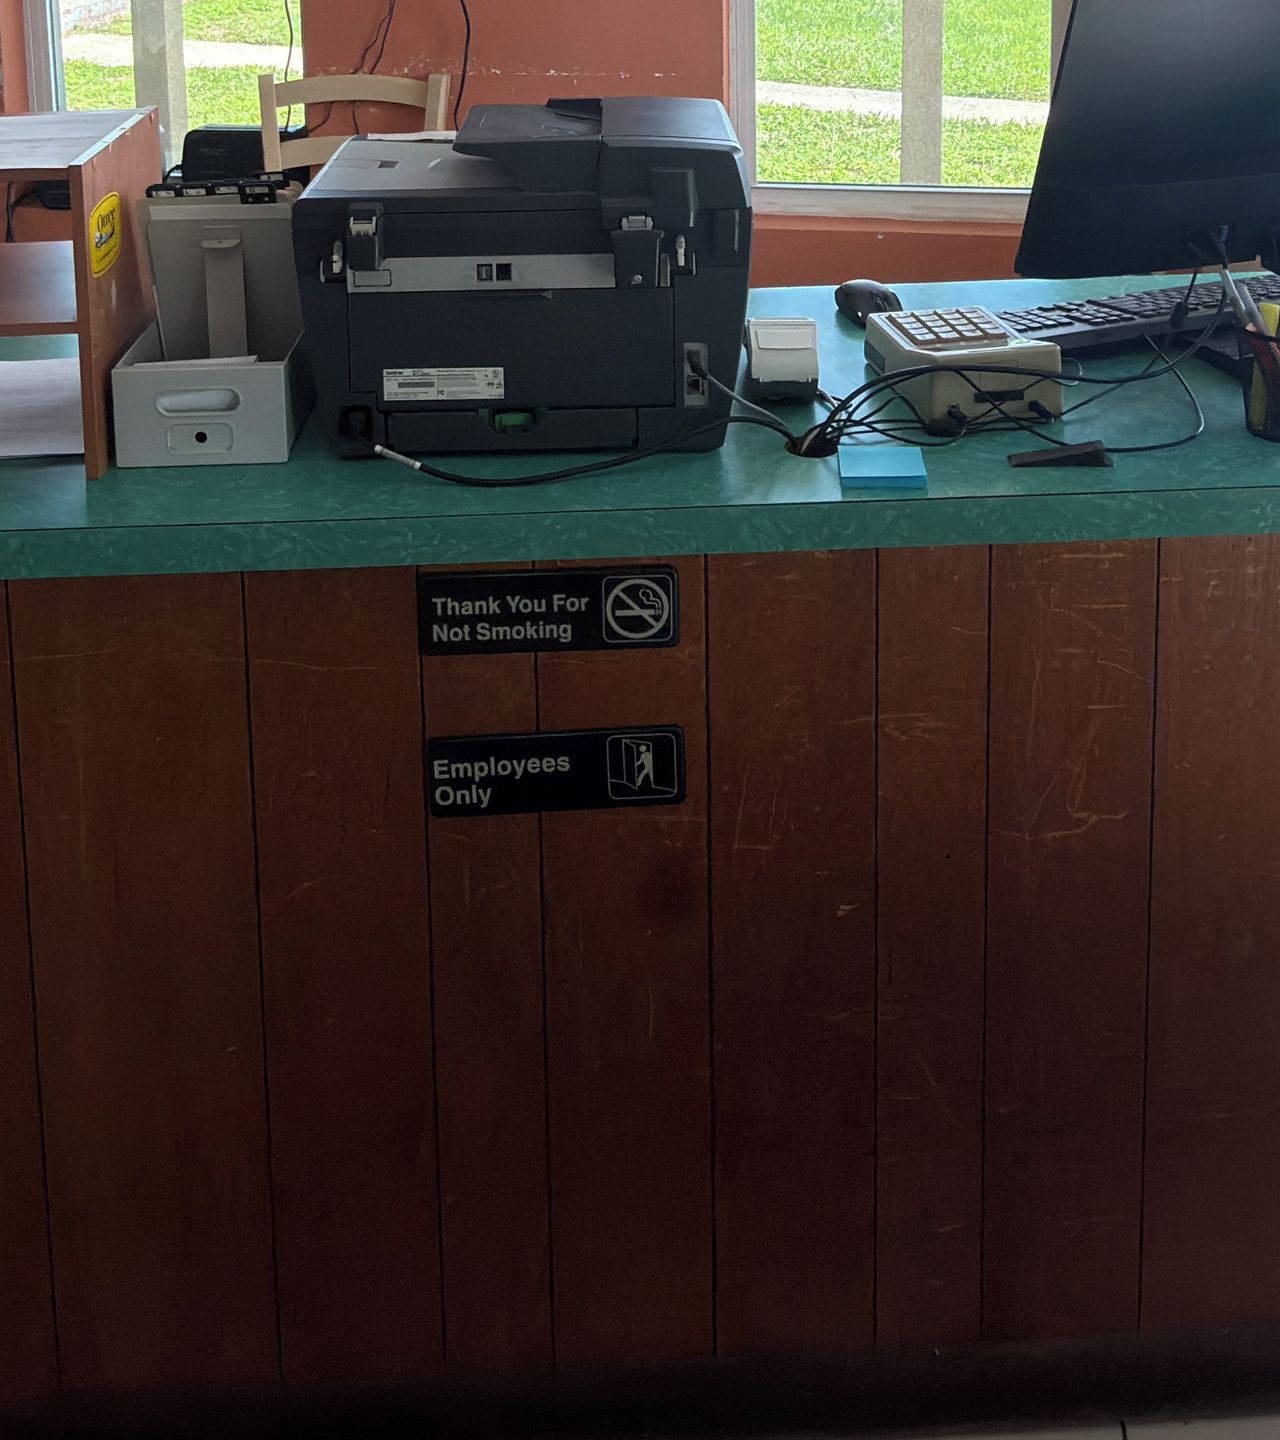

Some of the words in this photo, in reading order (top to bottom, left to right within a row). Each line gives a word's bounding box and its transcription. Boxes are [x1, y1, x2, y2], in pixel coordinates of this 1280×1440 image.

[431, 595, 502, 618] Thank
[506, 594, 547, 615] You
[552, 593, 590, 612] For
[431, 623, 471, 643] Not
[476, 620, 573, 643] Smoking
[432, 755, 571, 782] Employees
[434, 785, 492, 809] Only
